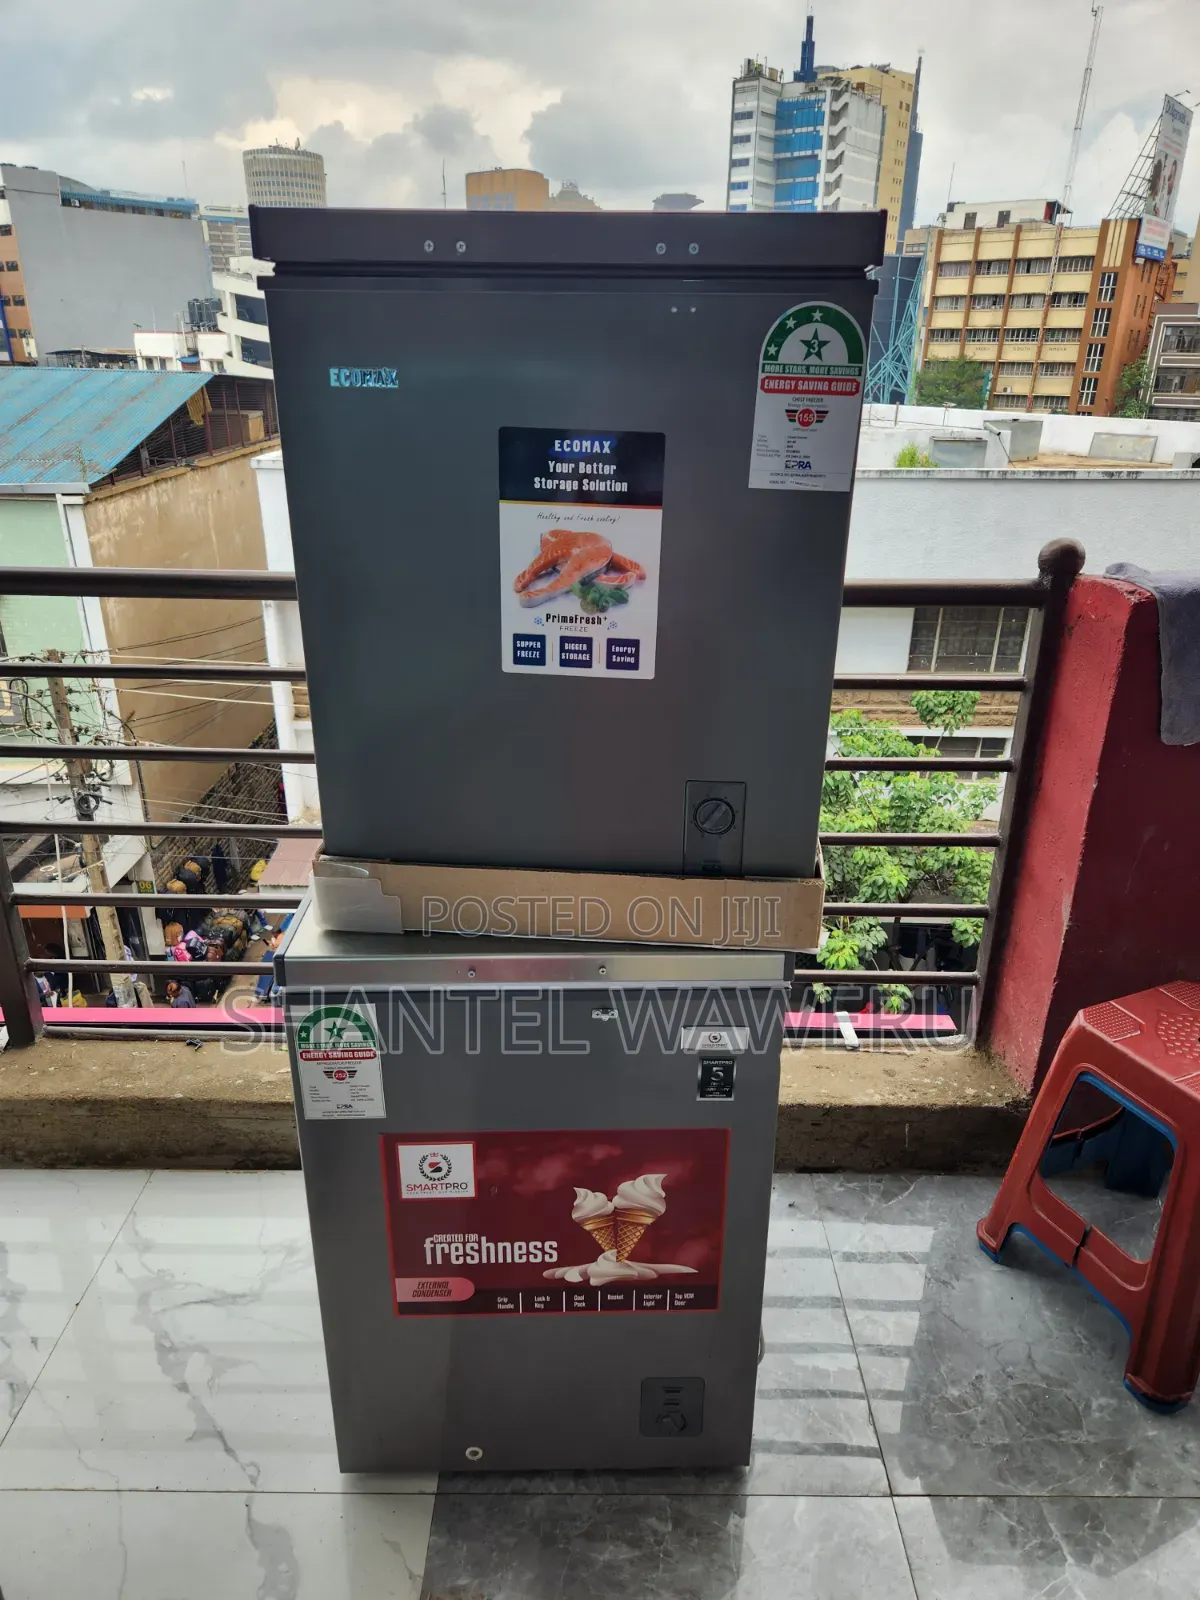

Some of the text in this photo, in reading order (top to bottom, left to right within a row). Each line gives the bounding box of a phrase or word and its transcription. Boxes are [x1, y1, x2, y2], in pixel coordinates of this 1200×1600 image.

[810, 339, 819, 353] 3
[764, 364, 783, 373] MORE
[809, 365, 828, 375] MORE
[829, 366, 859, 376] SAVINGS
[329, 368, 399, 388] ECOMAX
[764, 379, 857, 392] ENERGY SAVING GUIDE
[799, 413, 814, 422] 155
[554, 439, 611, 454] ECOMAX
[548, 461, 617, 475] Your Better
[785, 460, 812, 470] EPRA
[533, 477, 628, 492] Storage Solution
[537, 512, 560, 523] Healthy
[516, 640, 541, 649] SUPPER
[564, 642, 588, 651] BIGGER
[611, 644, 636, 654] Energy
[517, 650, 540, 659] FREEZE
[561, 652, 591, 661] STORAGE
[612, 654, 635, 664] Saving
[139, 880, 152, 890] 06
[328, 1051, 354, 1059] SAVING
[710, 1066, 724, 1081] 5
[406, 1182, 468, 1192] SMARTPRO
[434, 1234, 479, 1243] CREATED FOR
[424, 1236, 558, 1265] freshness
[417, 1281, 450, 1289] EXTERNAL
[412, 1289, 452, 1298] CONDENSER
